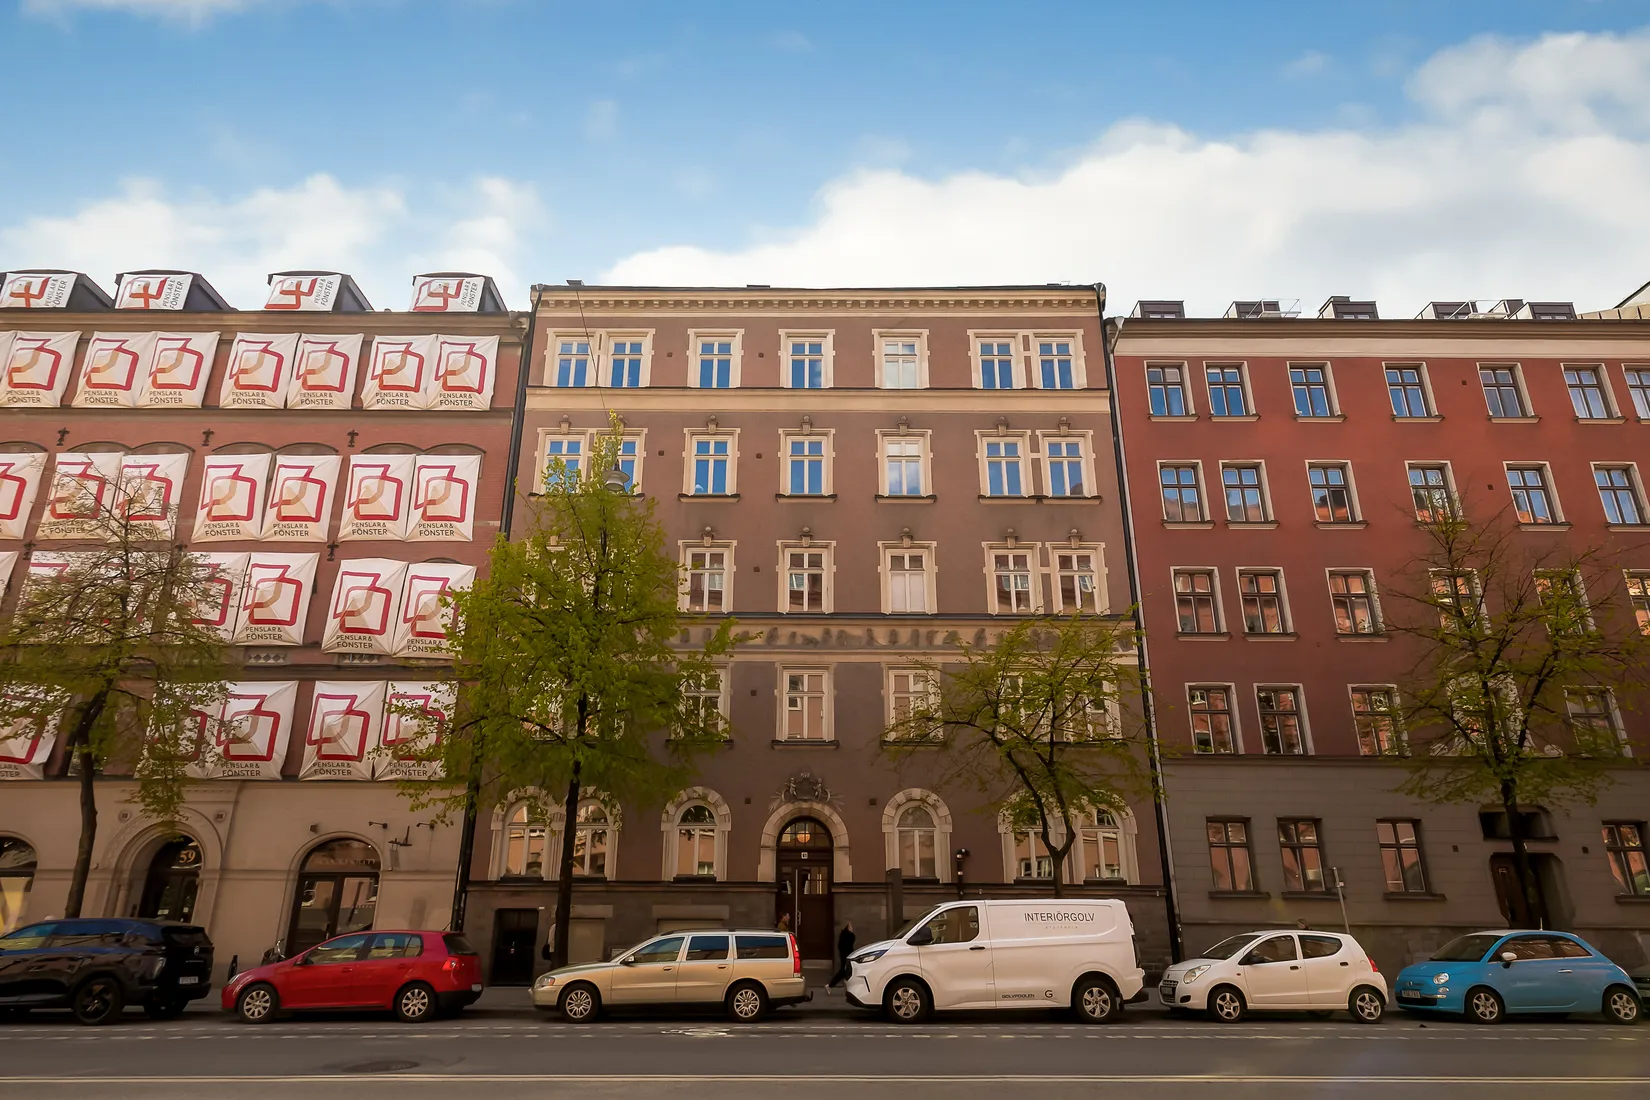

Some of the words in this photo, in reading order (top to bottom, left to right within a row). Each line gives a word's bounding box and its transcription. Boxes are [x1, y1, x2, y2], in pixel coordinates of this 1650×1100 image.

[84, 396, 119, 404] FÖNSTER
[232, 397, 266, 405] FÖNSTER
[205, 528, 241, 536] FÖNSTER
[246, 632, 283, 641] FÖNSTER
[336, 641, 373, 649] FÖNSTER
[222, 769, 261, 777] FÖNSTER
[313, 768, 352, 776] FÖNSTER
[178, 850, 196, 863] 59
[1024, 911, 1095, 922] INTERIÖRGOLV
[1044, 989, 1053, 998] G
